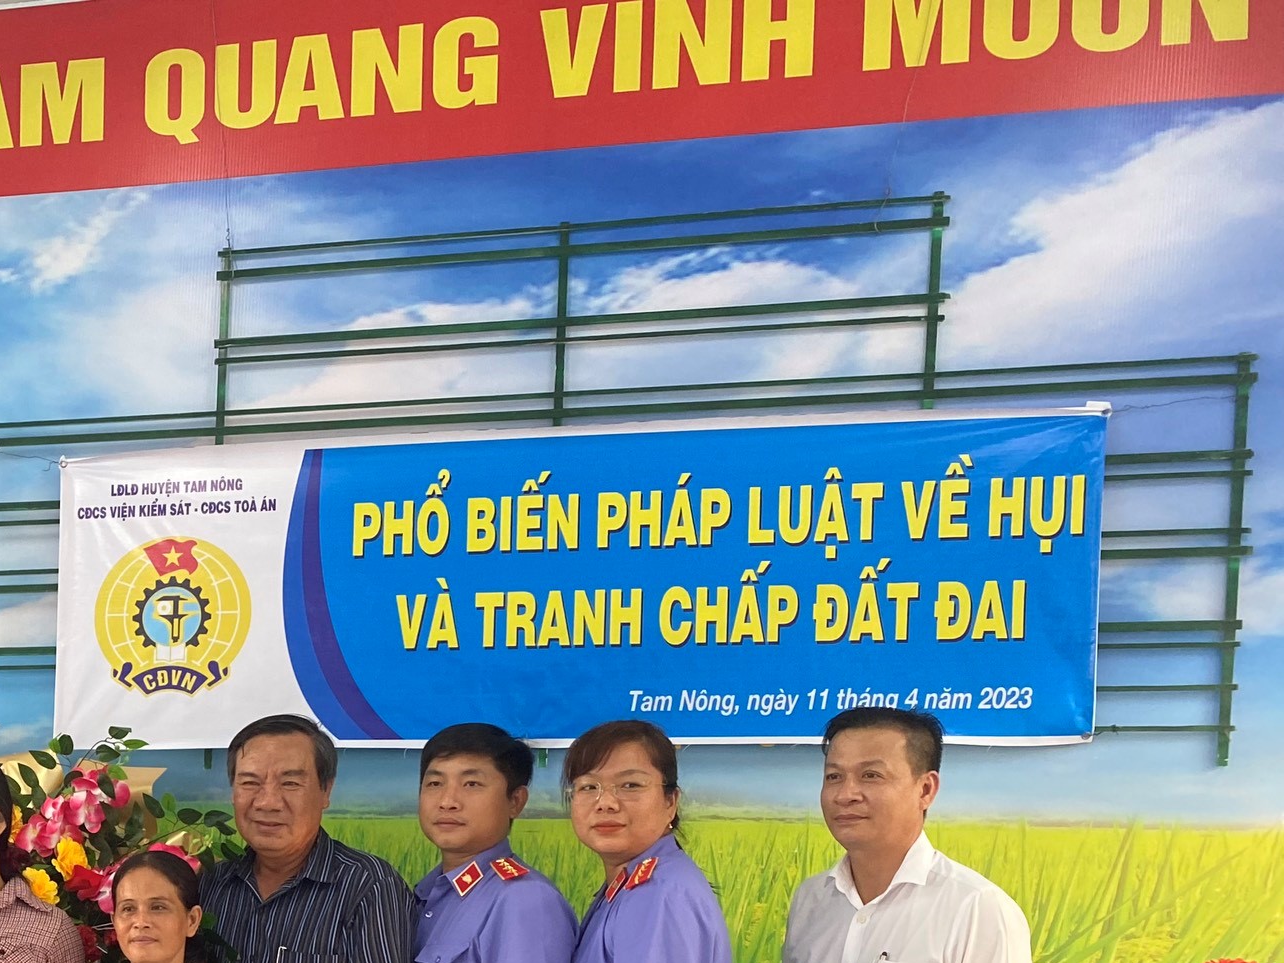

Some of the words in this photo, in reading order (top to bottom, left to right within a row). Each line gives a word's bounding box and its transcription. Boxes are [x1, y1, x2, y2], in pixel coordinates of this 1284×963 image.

[144, 17, 500, 145] QUANG
[541, 0, 815, 99] VINH
[110, 483, 139, 497] LĐLĐ
[141, 479, 180, 498] HUYỆN
[183, 480, 207, 493] TAM
[210, 476, 243, 492] NÔNG
[77, 506, 107, 520] CĐCS
[110, 502, 136, 522] VIỆN
[138, 498, 167, 518] KIỂM
[169, 499, 192, 516] SÁT
[200, 500, 231, 515] CĐCS
[234, 495, 257, 513] TOÀ
[260, 495, 277, 512] ÁN
[351, 468, 451, 557] PHỔ
[465, 470, 580, 553] BIẾN
[596, 473, 733, 549] PHÁP
[748, 467, 885, 561] LUẬT
[902, 455, 976, 541] VỀ
[988, 474, 1088, 555] HỤI
[396, 577, 460, 651] VÀ
[475, 589, 644, 650] TRANH
[658, 560, 800, 647] CHẤP
[812, 557, 921, 644] ĐẤT
[933, 580, 1028, 641] ĐAI
[142, 669, 198, 691] CĐVN
[628, 689, 674, 712] Tam
[678, 689, 740, 717] Nông,
[746, 687, 800, 716] ngày
[806, 688, 830, 711] 11
[836, 687, 900, 710] tháng
[904, 688, 919, 710] 4
[924, 687, 973, 710] năm
[977, 686, 1034, 710] 2023
